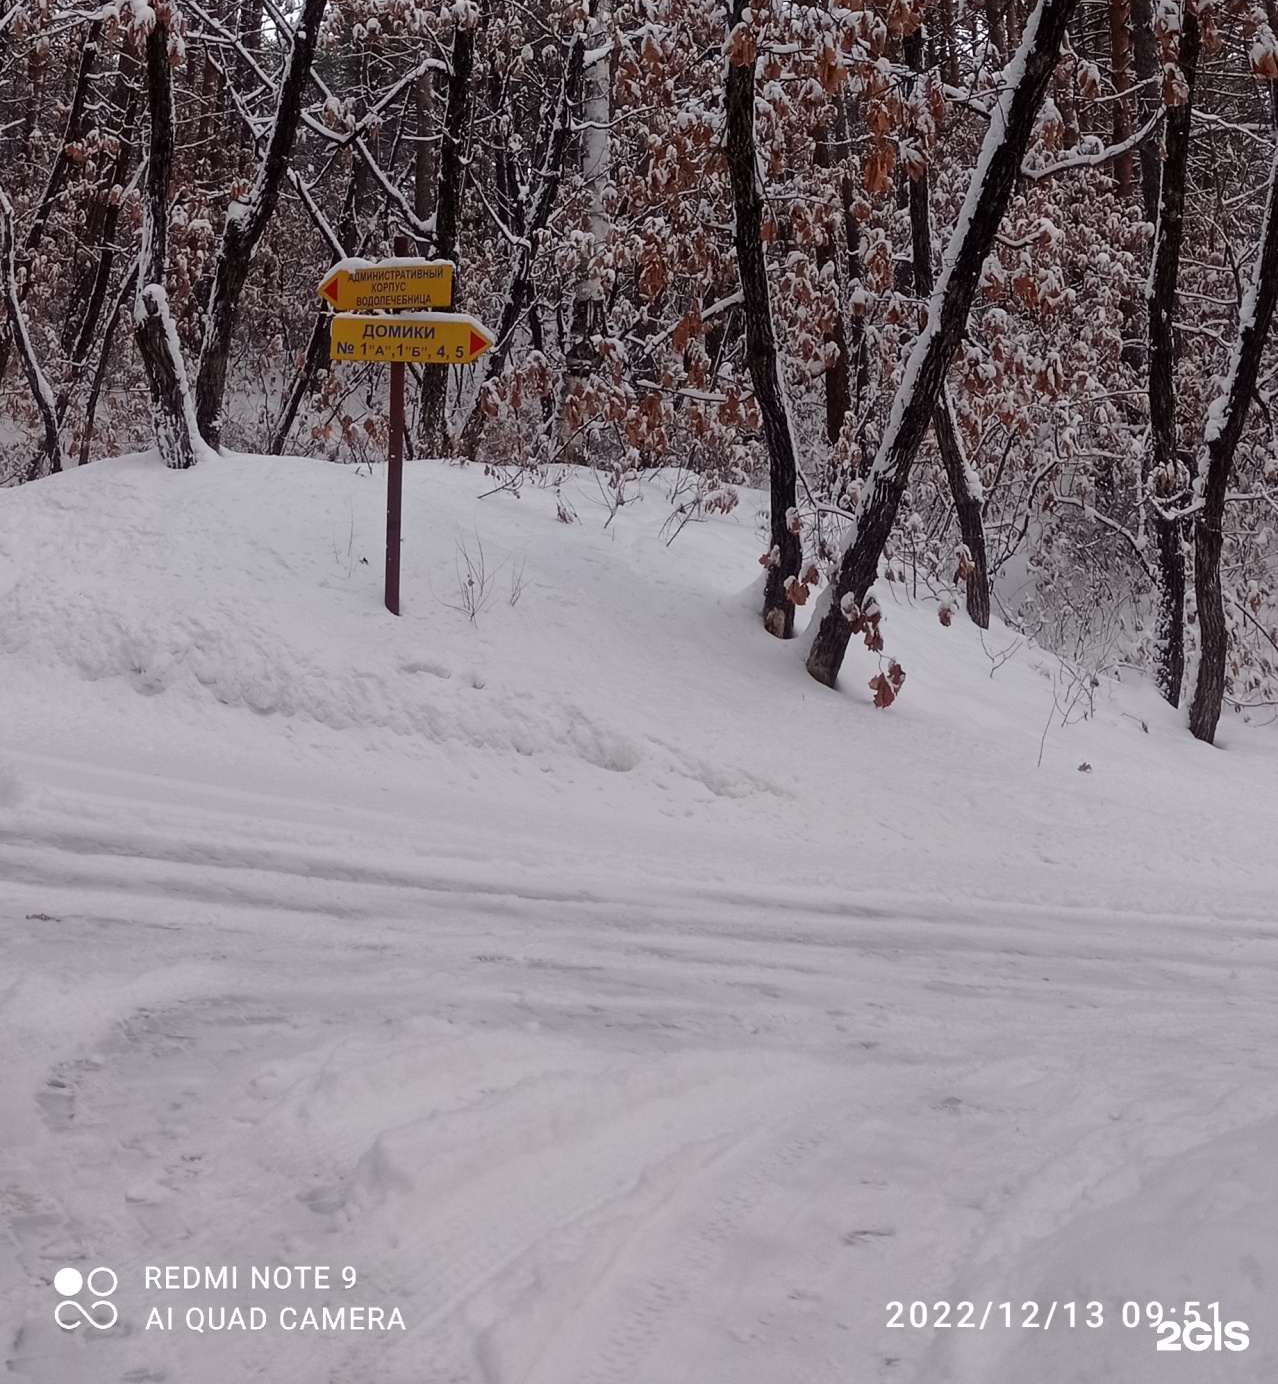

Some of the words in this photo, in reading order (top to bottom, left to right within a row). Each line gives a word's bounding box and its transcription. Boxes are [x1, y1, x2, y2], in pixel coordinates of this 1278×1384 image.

[348, 268, 443, 283] АДМИНИСТРАТИВНЫЙ
[371, 282, 406, 293] КОРПУС
[356, 294, 431, 308] ВОДОЛЕЧЕБНИЦА
[362, 324, 435, 339] ДОМИКИ
[337, 342, 354, 354] №
[455, 346, 464, 358] 5
